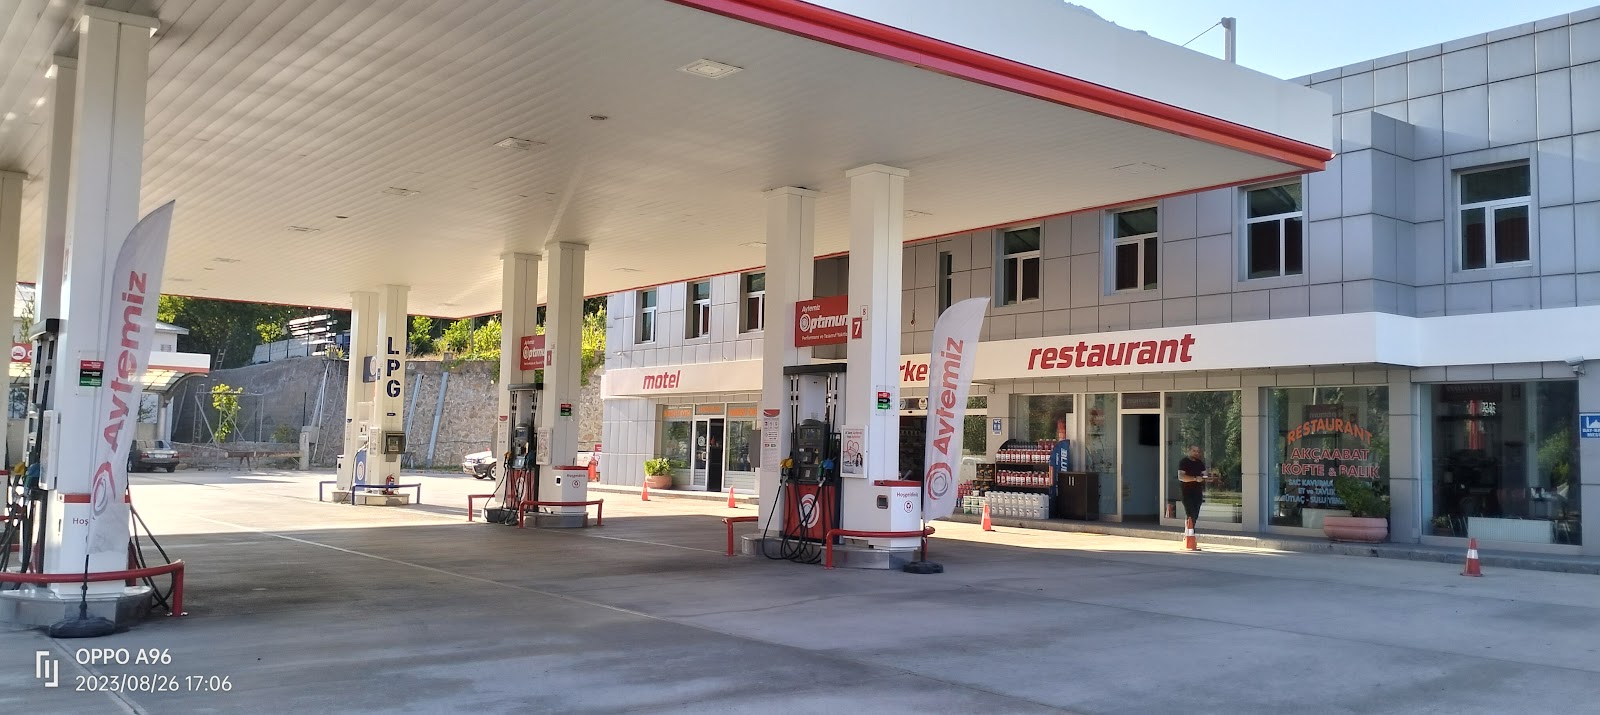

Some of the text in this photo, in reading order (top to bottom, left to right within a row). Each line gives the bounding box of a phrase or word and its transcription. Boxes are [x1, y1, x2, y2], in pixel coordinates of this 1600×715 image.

[853, 321, 861, 336] 7
[104, 270, 147, 453] Aytemiz
[1028, 333, 1196, 370] restaurant
[386, 337, 401, 398] LPG
[643, 370, 681, 389] motel
[932, 336, 964, 456] Aytemiz
[1287, 418, 1372, 445] RESTAURANT
[1281, 460, 1325, 476] KÖFTE
[1328, 467, 1336, 476] &
[1291, 448, 1369, 463] AKÇAABAT
